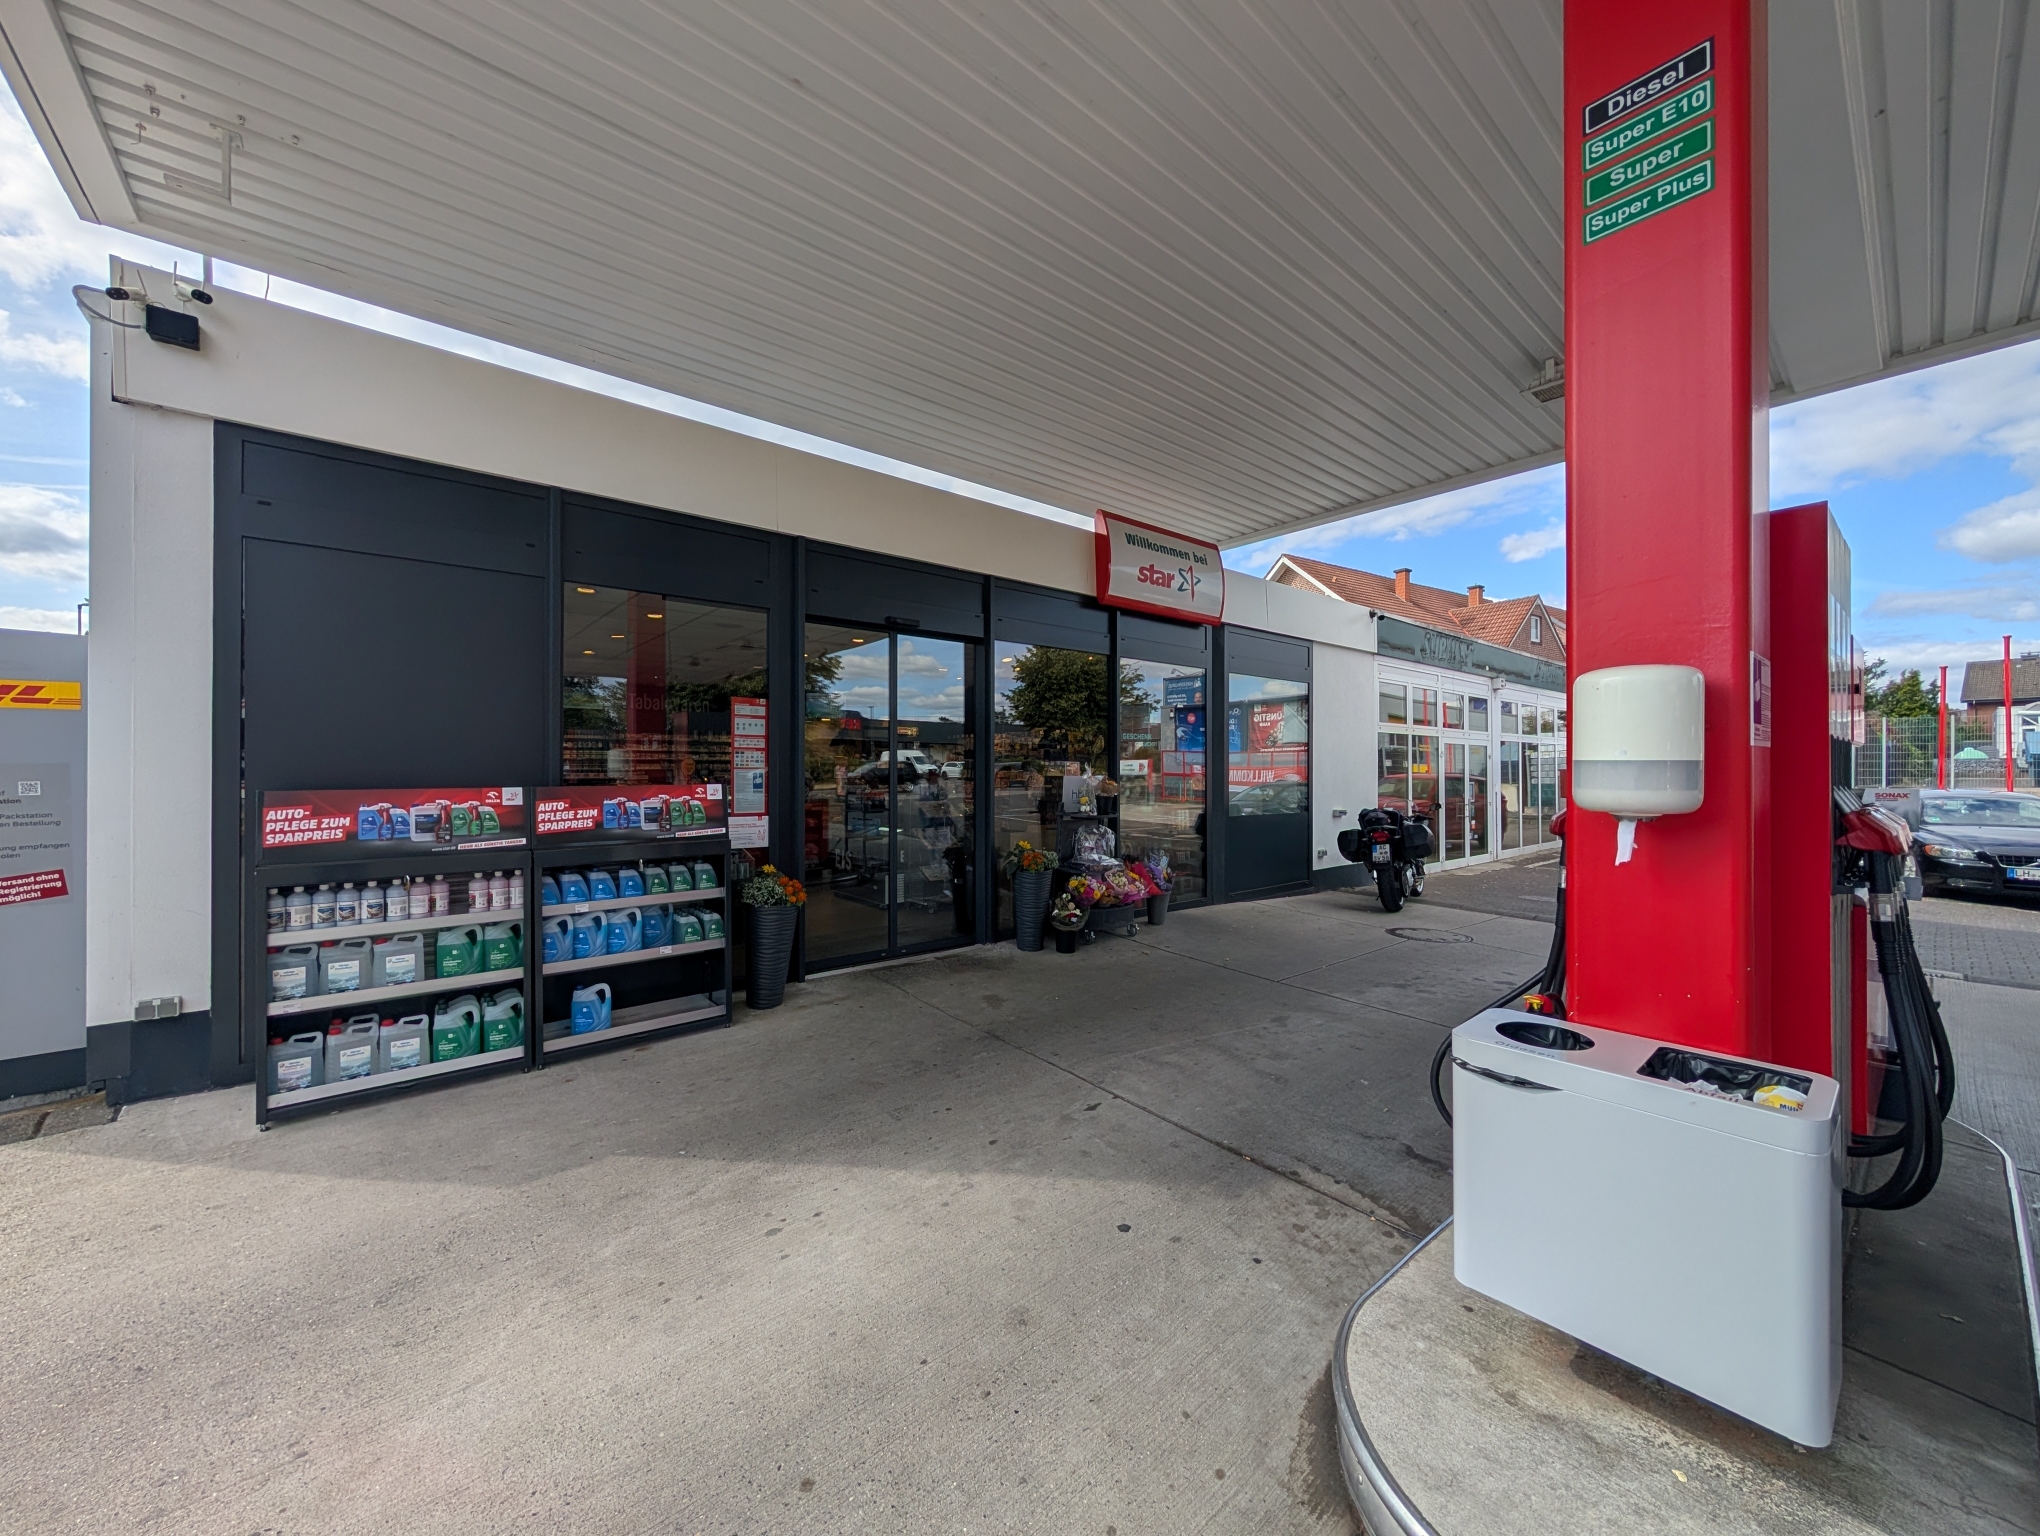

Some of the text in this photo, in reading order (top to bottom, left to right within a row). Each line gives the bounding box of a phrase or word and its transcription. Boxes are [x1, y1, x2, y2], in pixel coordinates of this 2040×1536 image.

[1608, 61, 1684, 116] Diesel
[1590, 90, 1704, 158] Super E10
[1610, 142, 1684, 186] Super
[1591, 171, 1705, 231] Super Plus
[1124, 532, 1208, 566] Willkommen bei
[1138, 564, 1175, 588] star
[266, 808, 310, 820] AUTO-
[538, 802, 569, 812] AUTO-
[538, 809, 598, 821] PFLEGE ZUM
[266, 816, 350, 832] PFLEGE ZUM
[538, 819, 593, 831] SPARPREIS
[265, 829, 343, 844] SPARPREIS
[18, 842, 70, 850] empfangen
[36, 873, 60, 882] ohne
